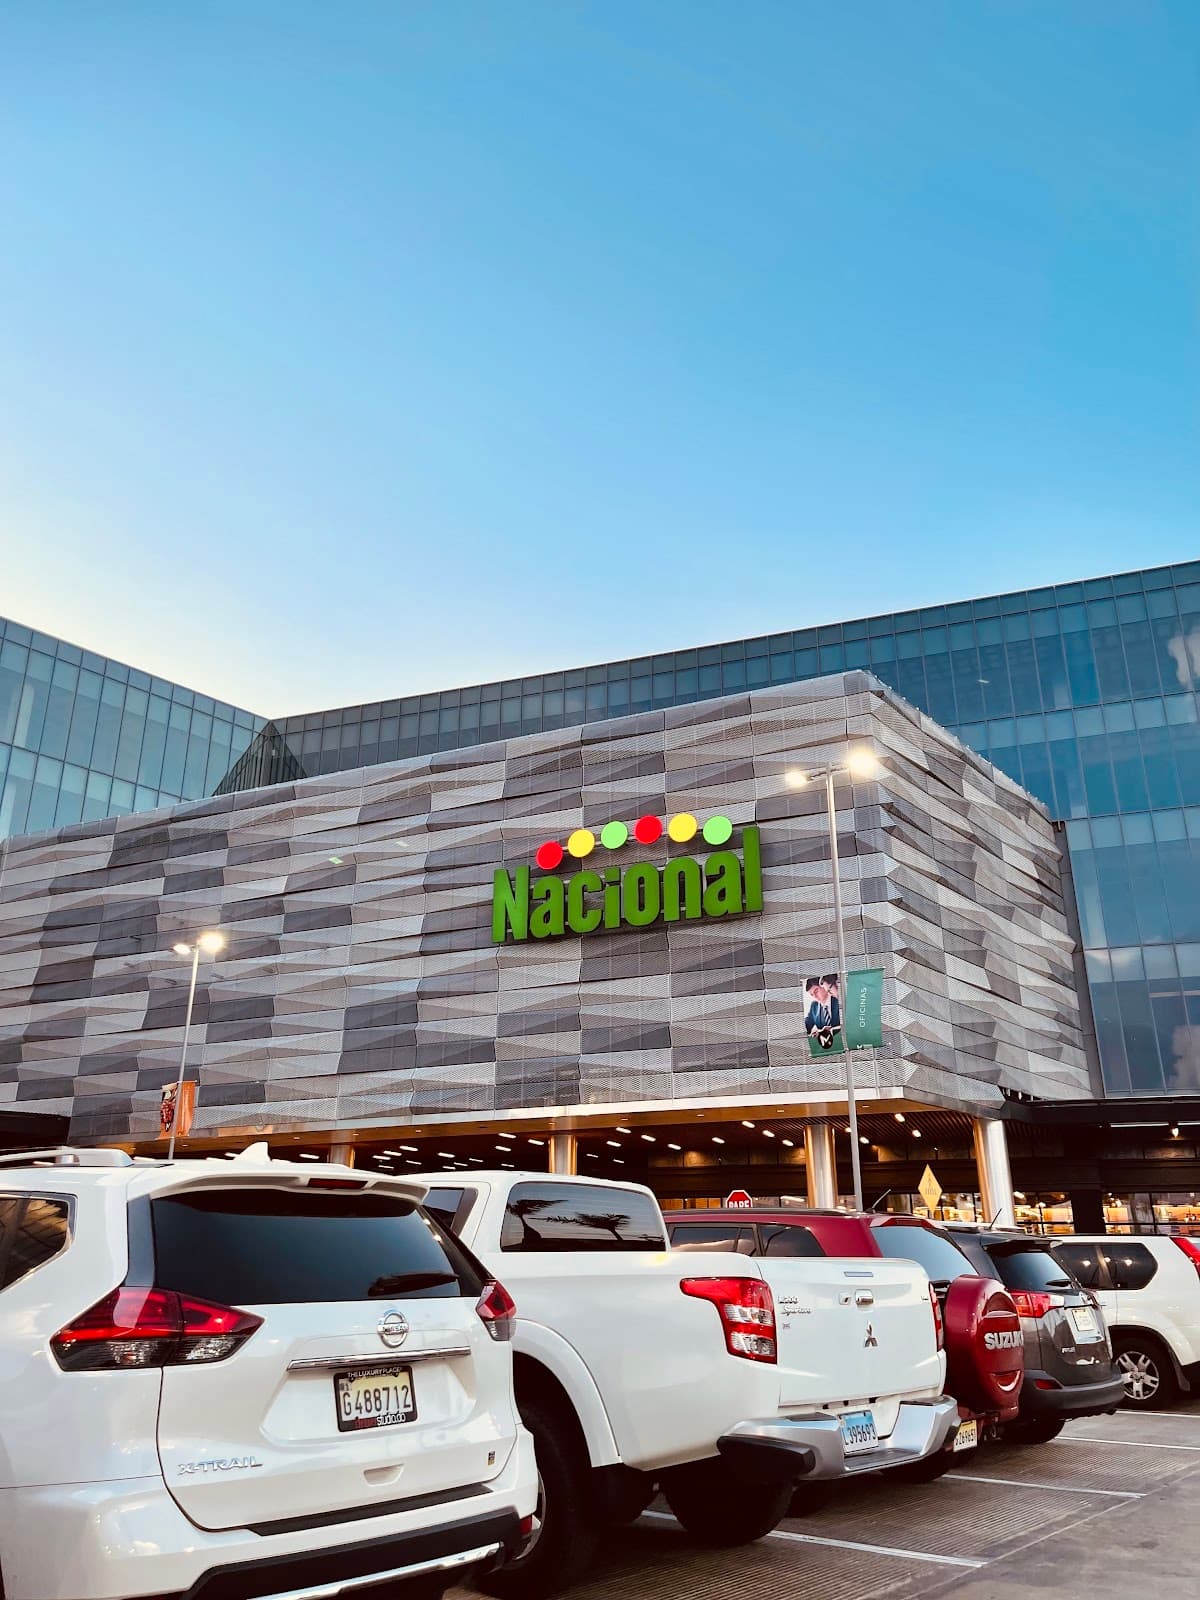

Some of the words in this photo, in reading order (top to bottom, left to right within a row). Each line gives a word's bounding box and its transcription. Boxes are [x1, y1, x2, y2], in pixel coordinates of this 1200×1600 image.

[491, 826, 764, 944] Nacional
[859, 987, 868, 1028] OFICINAS
[359, 1368, 382, 1377] LUXURY
[342, 1385, 411, 1416] G488712
[177, 1456, 263, 1476] X-TRAIL
